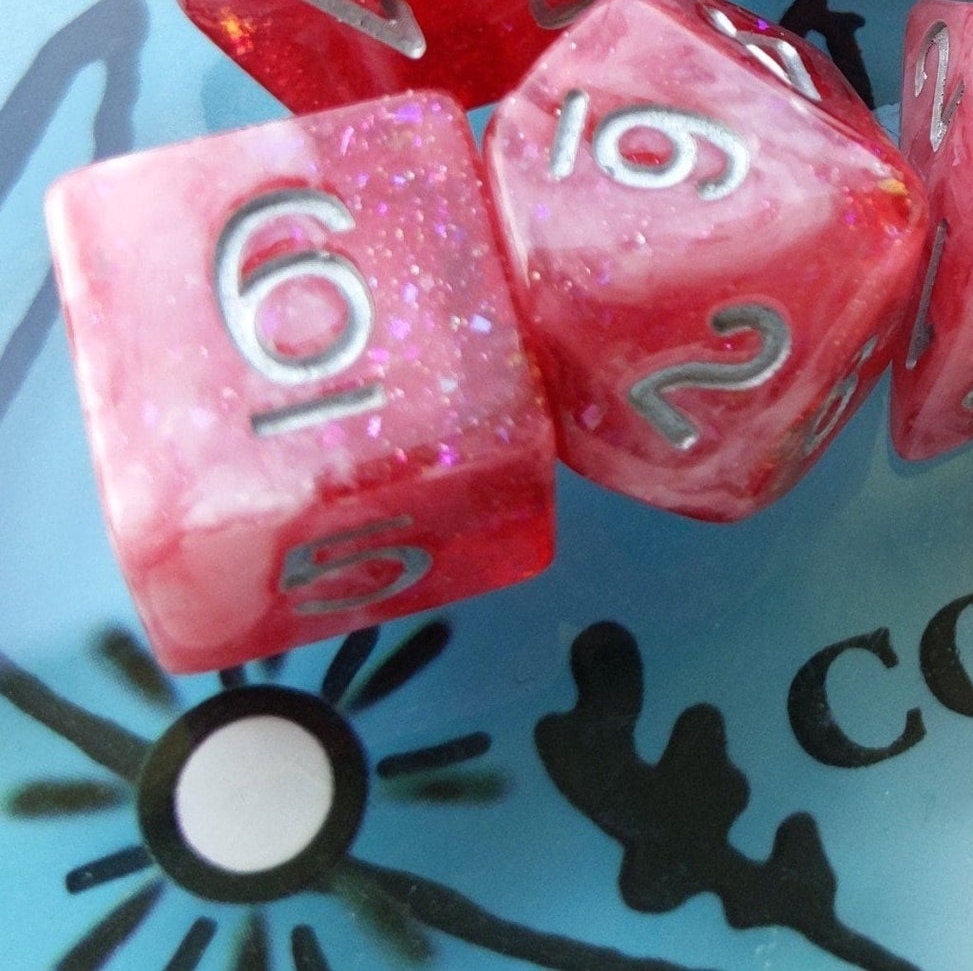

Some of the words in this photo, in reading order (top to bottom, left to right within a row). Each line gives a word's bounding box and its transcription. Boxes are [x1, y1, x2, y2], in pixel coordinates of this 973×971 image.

[212, 184, 377, 387] 6
[628, 301, 793, 450] 2
[280, 514, 434, 616] 5
